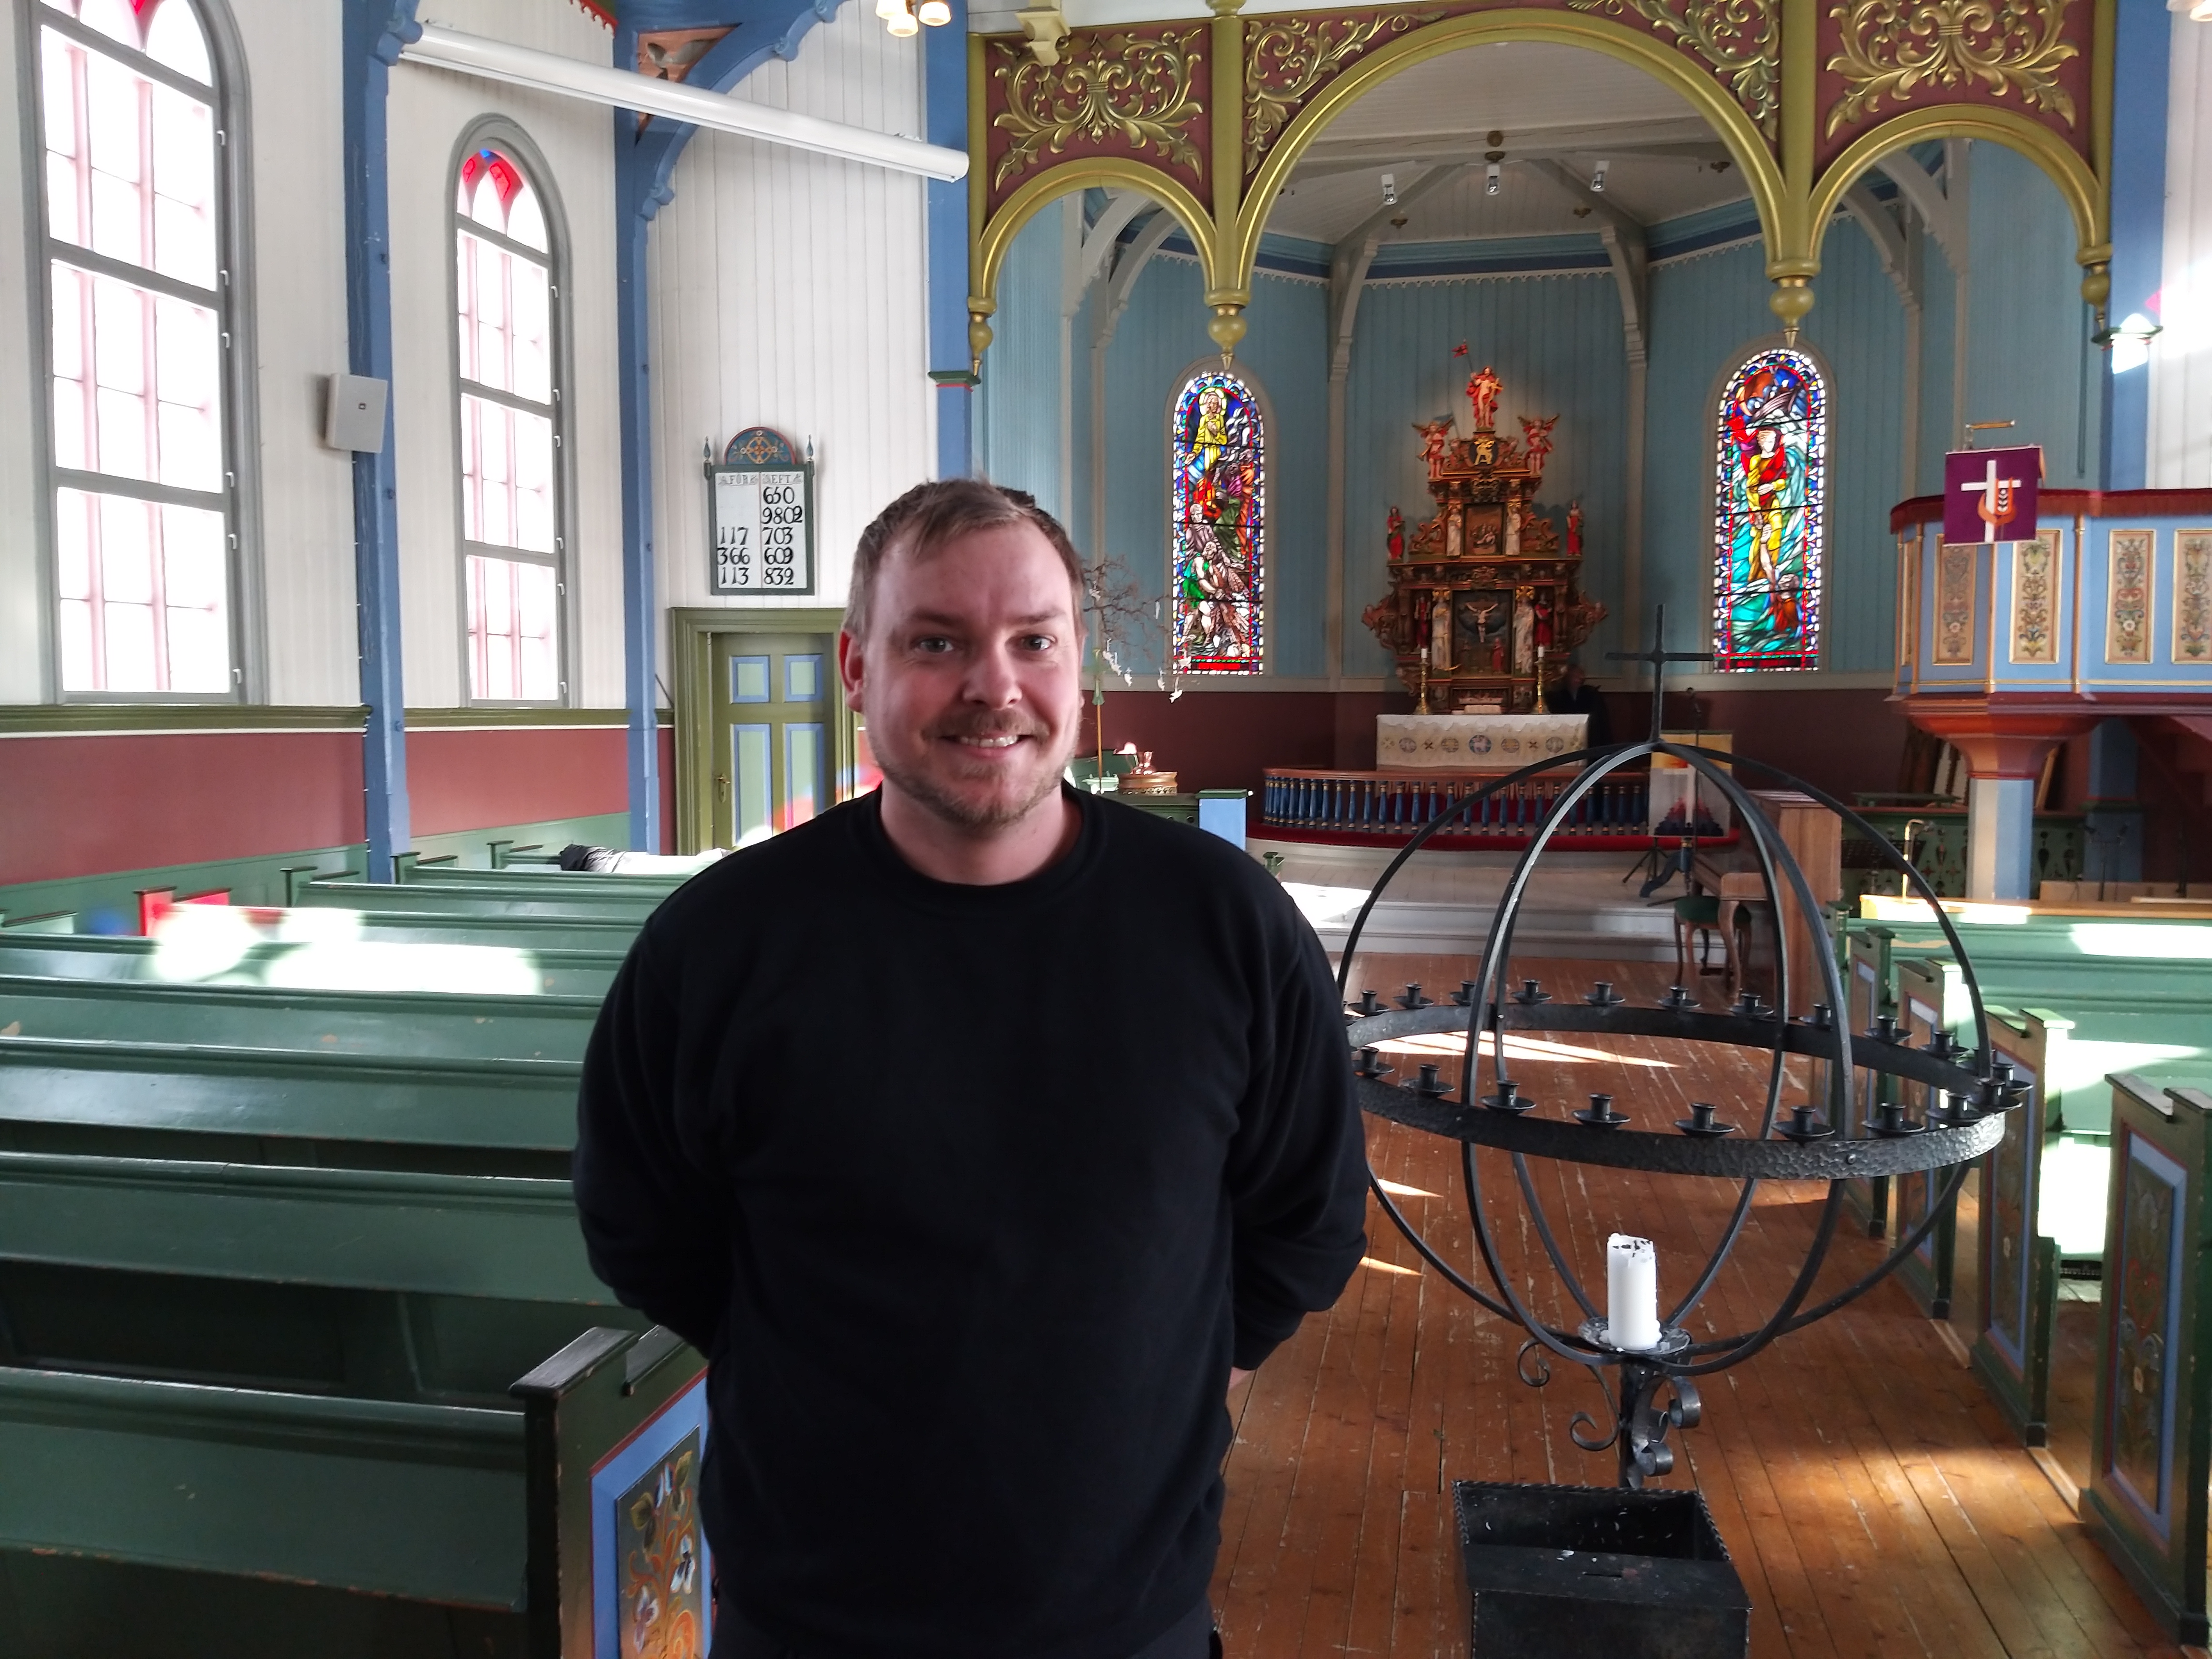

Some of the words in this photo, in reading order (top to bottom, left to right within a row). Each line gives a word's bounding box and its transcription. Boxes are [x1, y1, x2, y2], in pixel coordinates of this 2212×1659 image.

[763, 486, 795, 504] 650
[720, 527, 748, 545] 117
[762, 526, 793, 545] 703
[717, 547, 750, 565] 366
[764, 547, 793, 565] 609
[721, 567, 749, 585] 113
[764, 567, 794, 585] 832
